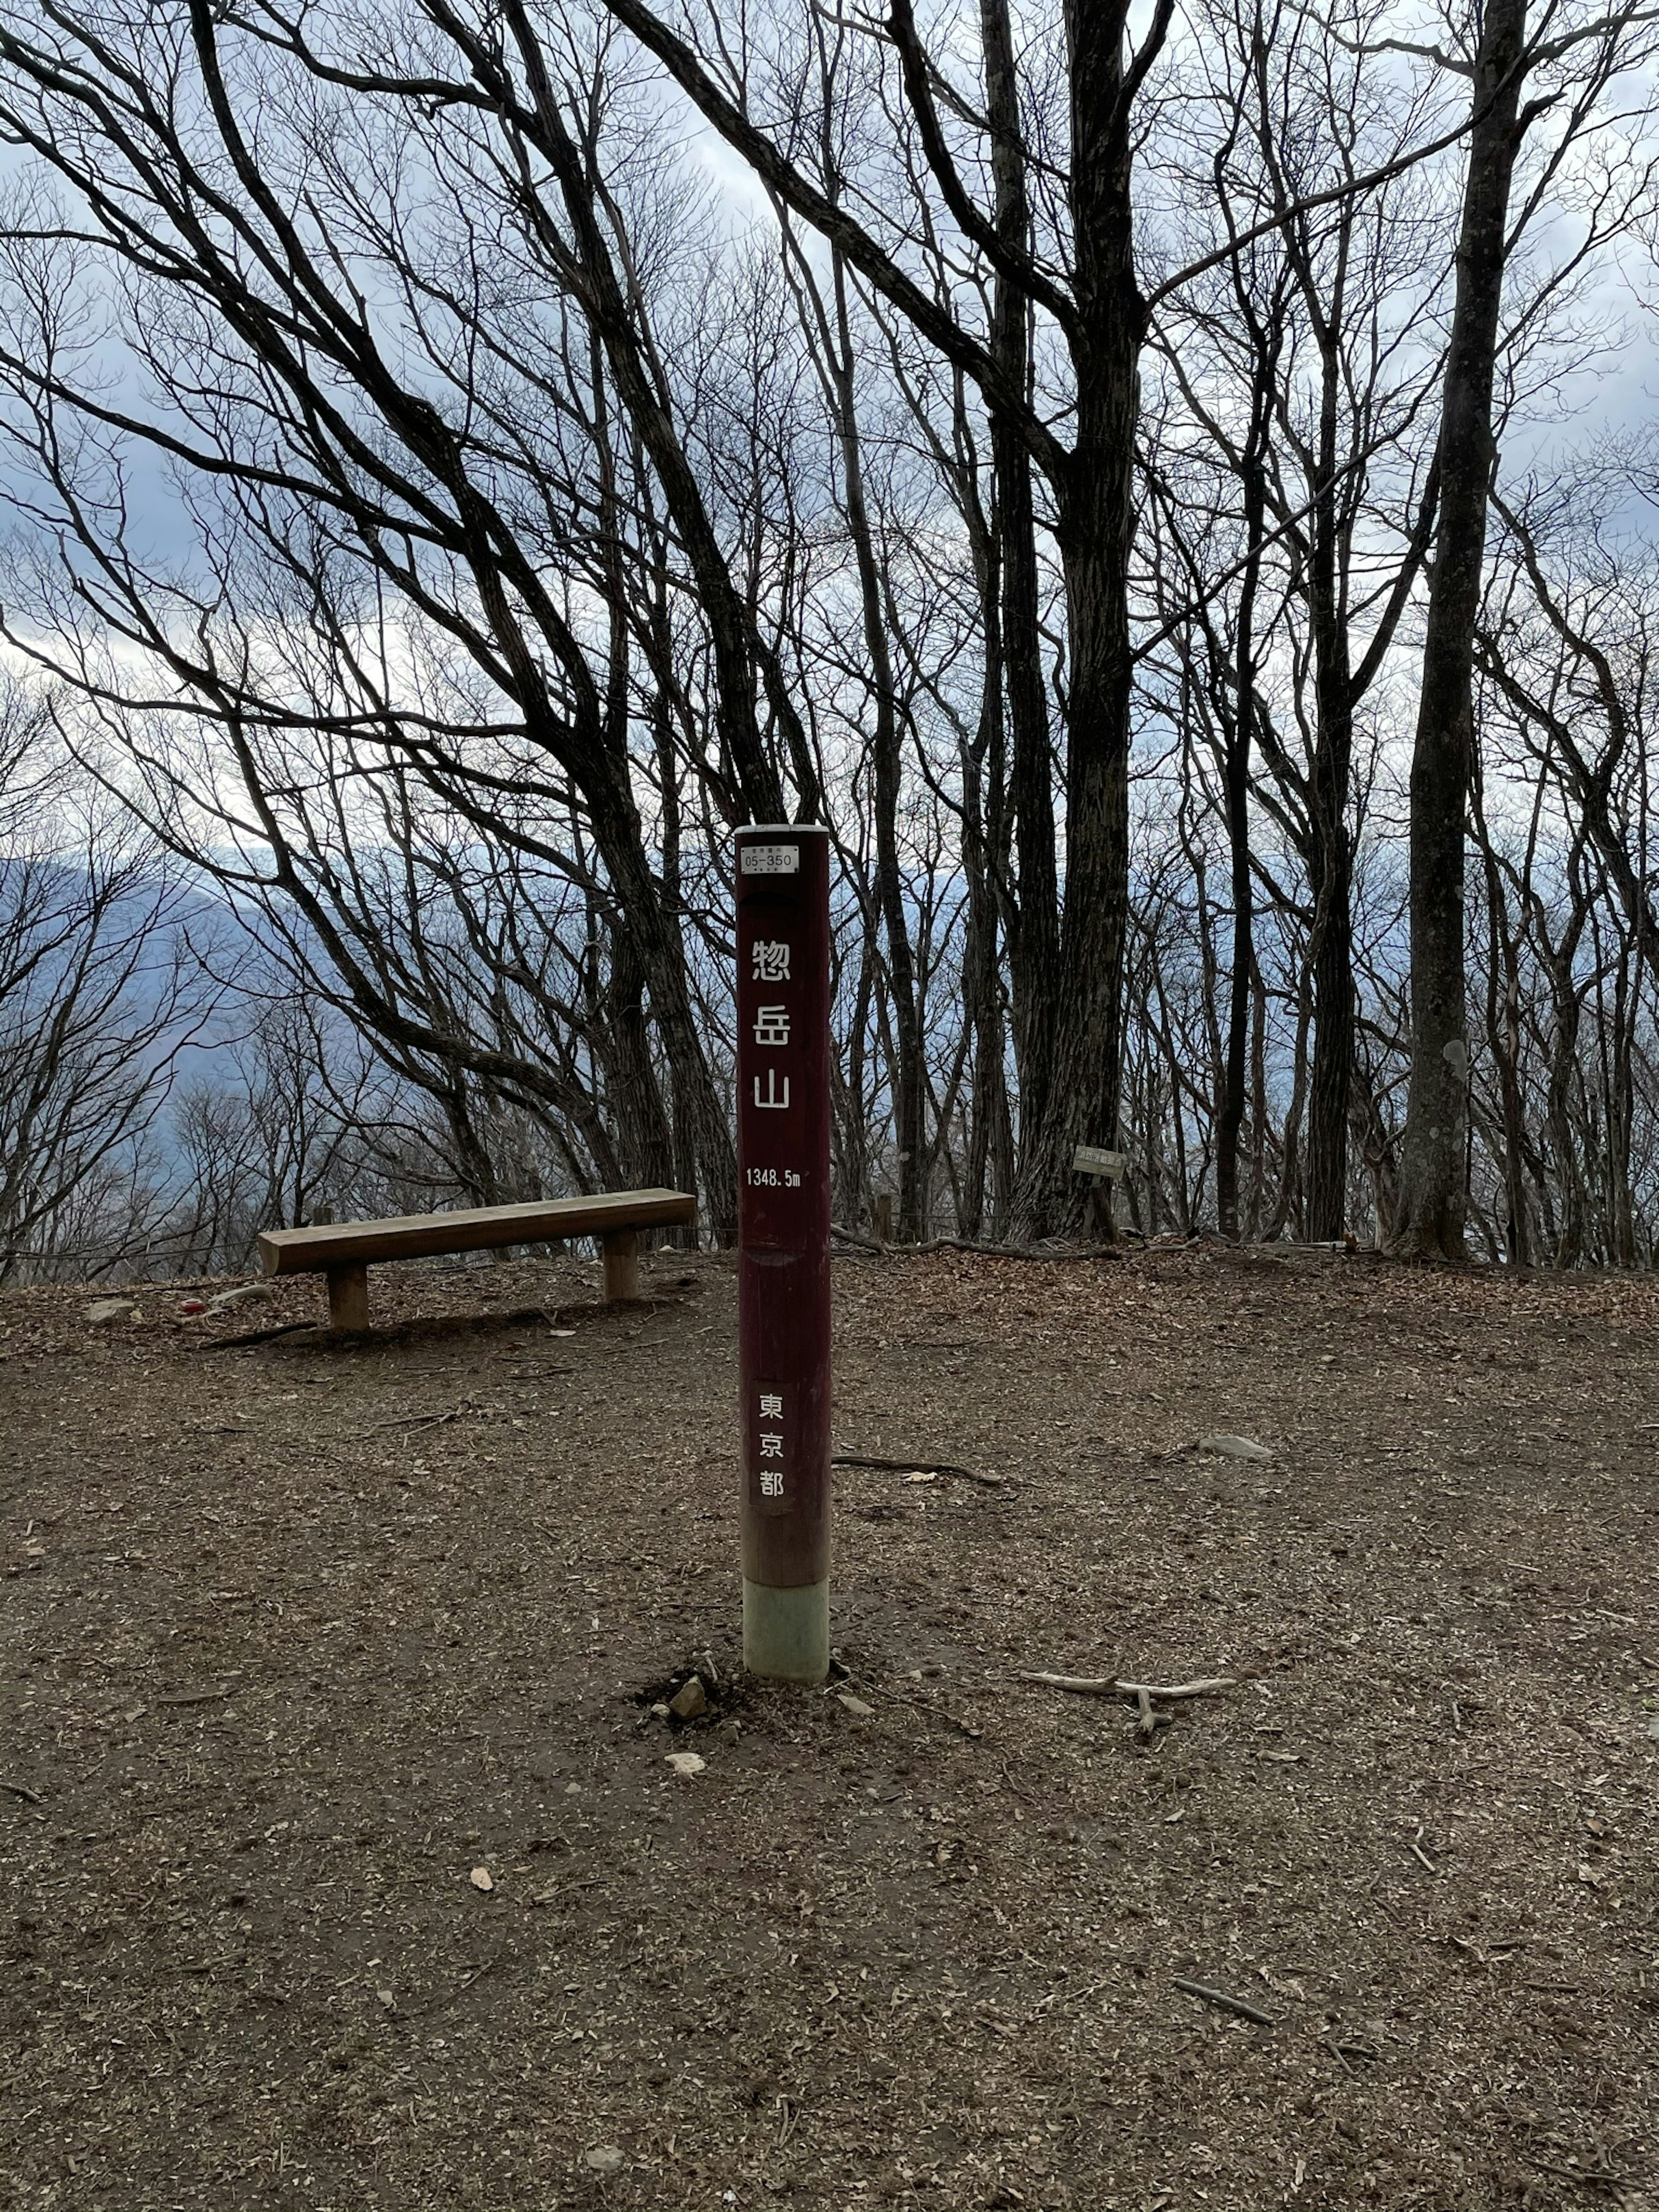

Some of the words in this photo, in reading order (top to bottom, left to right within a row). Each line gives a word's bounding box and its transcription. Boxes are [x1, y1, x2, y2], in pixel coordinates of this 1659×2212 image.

[745, 855, 791, 866] 05-350
[752, 940, 791, 1109] 惣岳山
[747, 1168, 801, 1187] 1348.5m
[759, 1393, 784, 1497] 東京都
